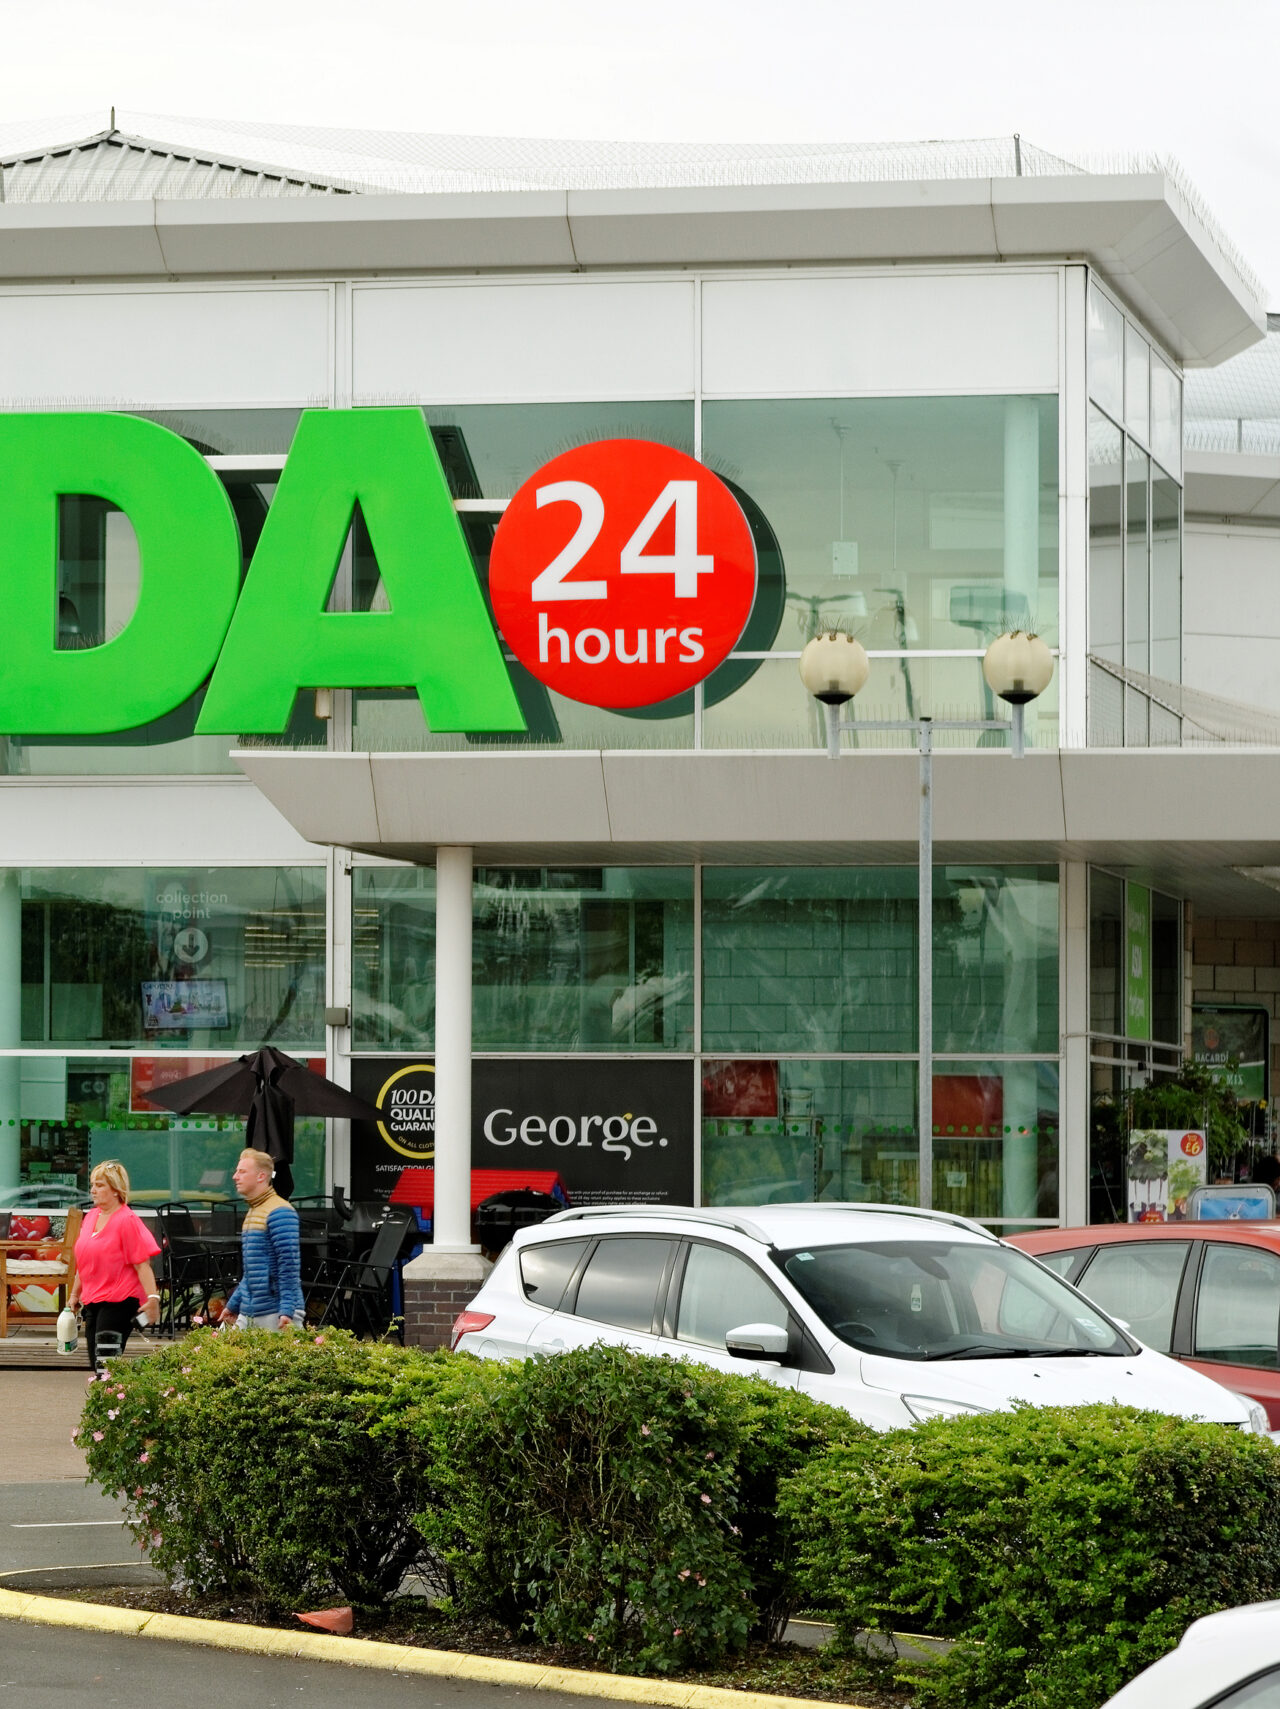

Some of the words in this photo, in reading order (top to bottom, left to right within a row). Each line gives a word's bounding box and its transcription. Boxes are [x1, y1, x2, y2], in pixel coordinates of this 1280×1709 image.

[531, 480, 714, 602] 24
[538, 612, 705, 664] hours
[156, 890, 228, 904] collection
[173, 907, 211, 920] point
[391, 1089, 417, 1105] 100
[391, 1109, 435, 1120] QUALI
